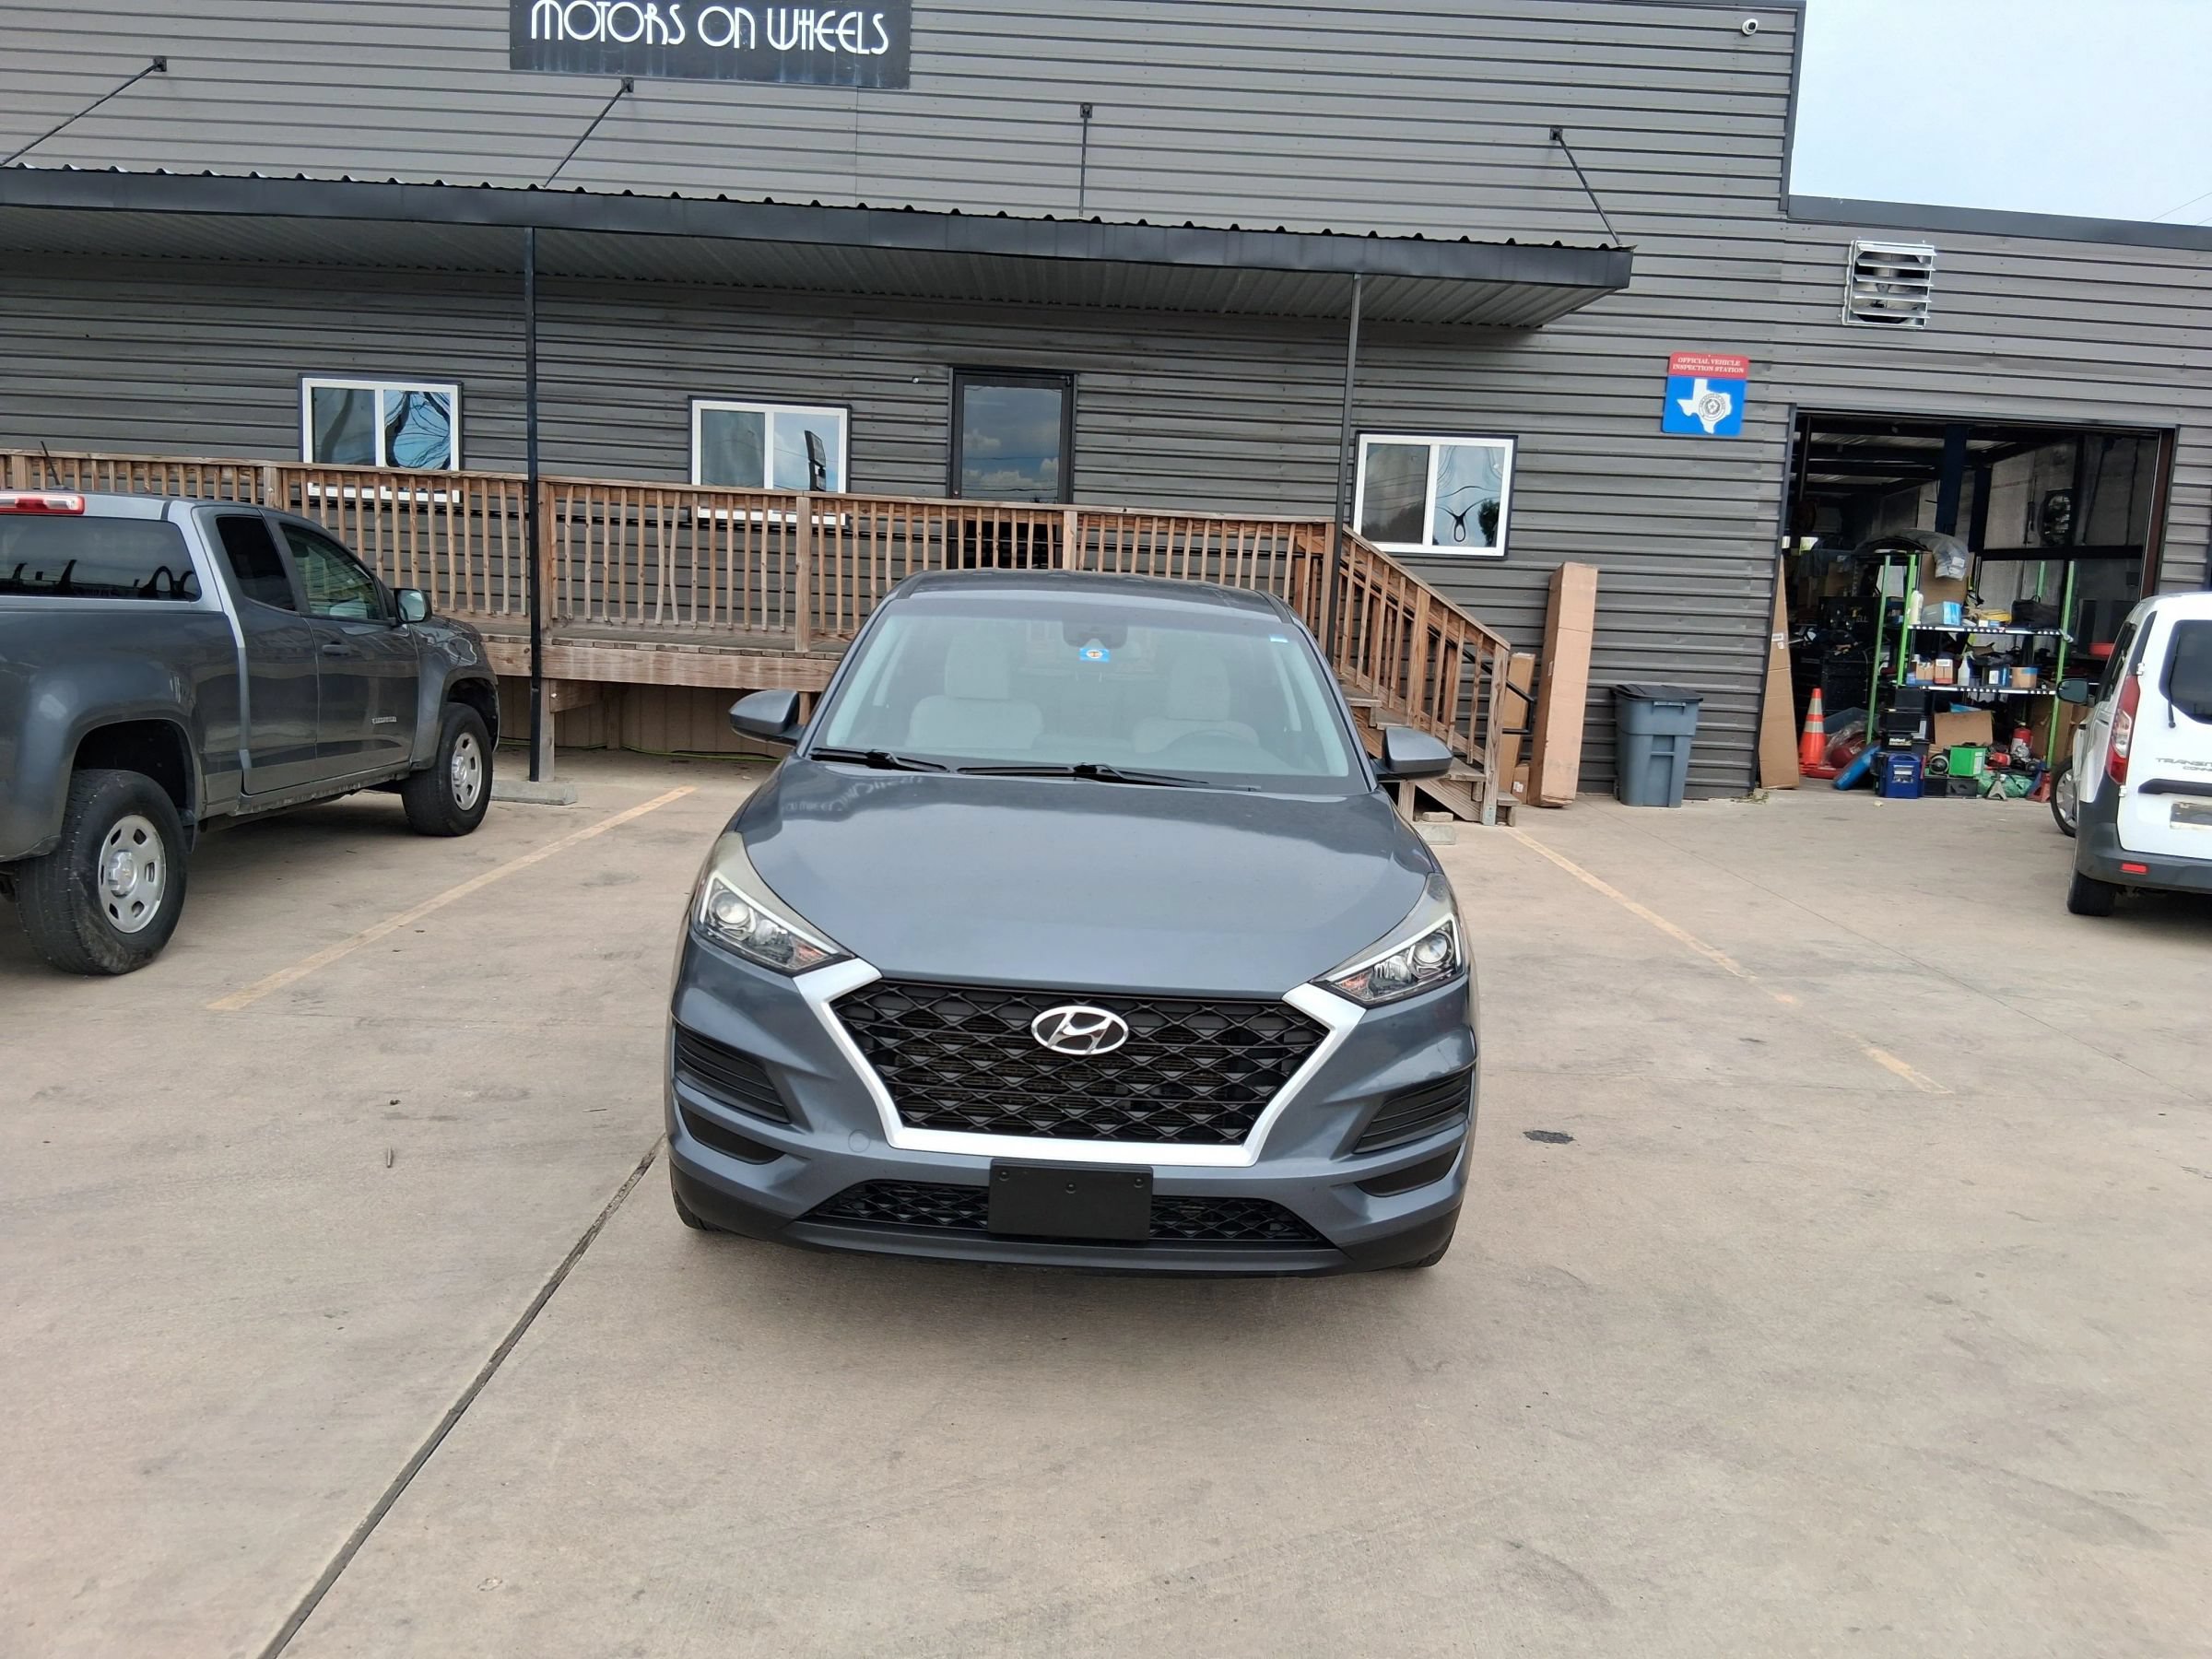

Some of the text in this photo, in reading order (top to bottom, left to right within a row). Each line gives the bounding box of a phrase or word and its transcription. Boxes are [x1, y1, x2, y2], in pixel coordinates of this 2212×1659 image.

[531, 0, 889, 55] MOTORS ON WHEELS
[1677, 357, 1741, 367] OFFICIAL VEHICLE
[1672, 363, 1714, 372] INSPECTION
